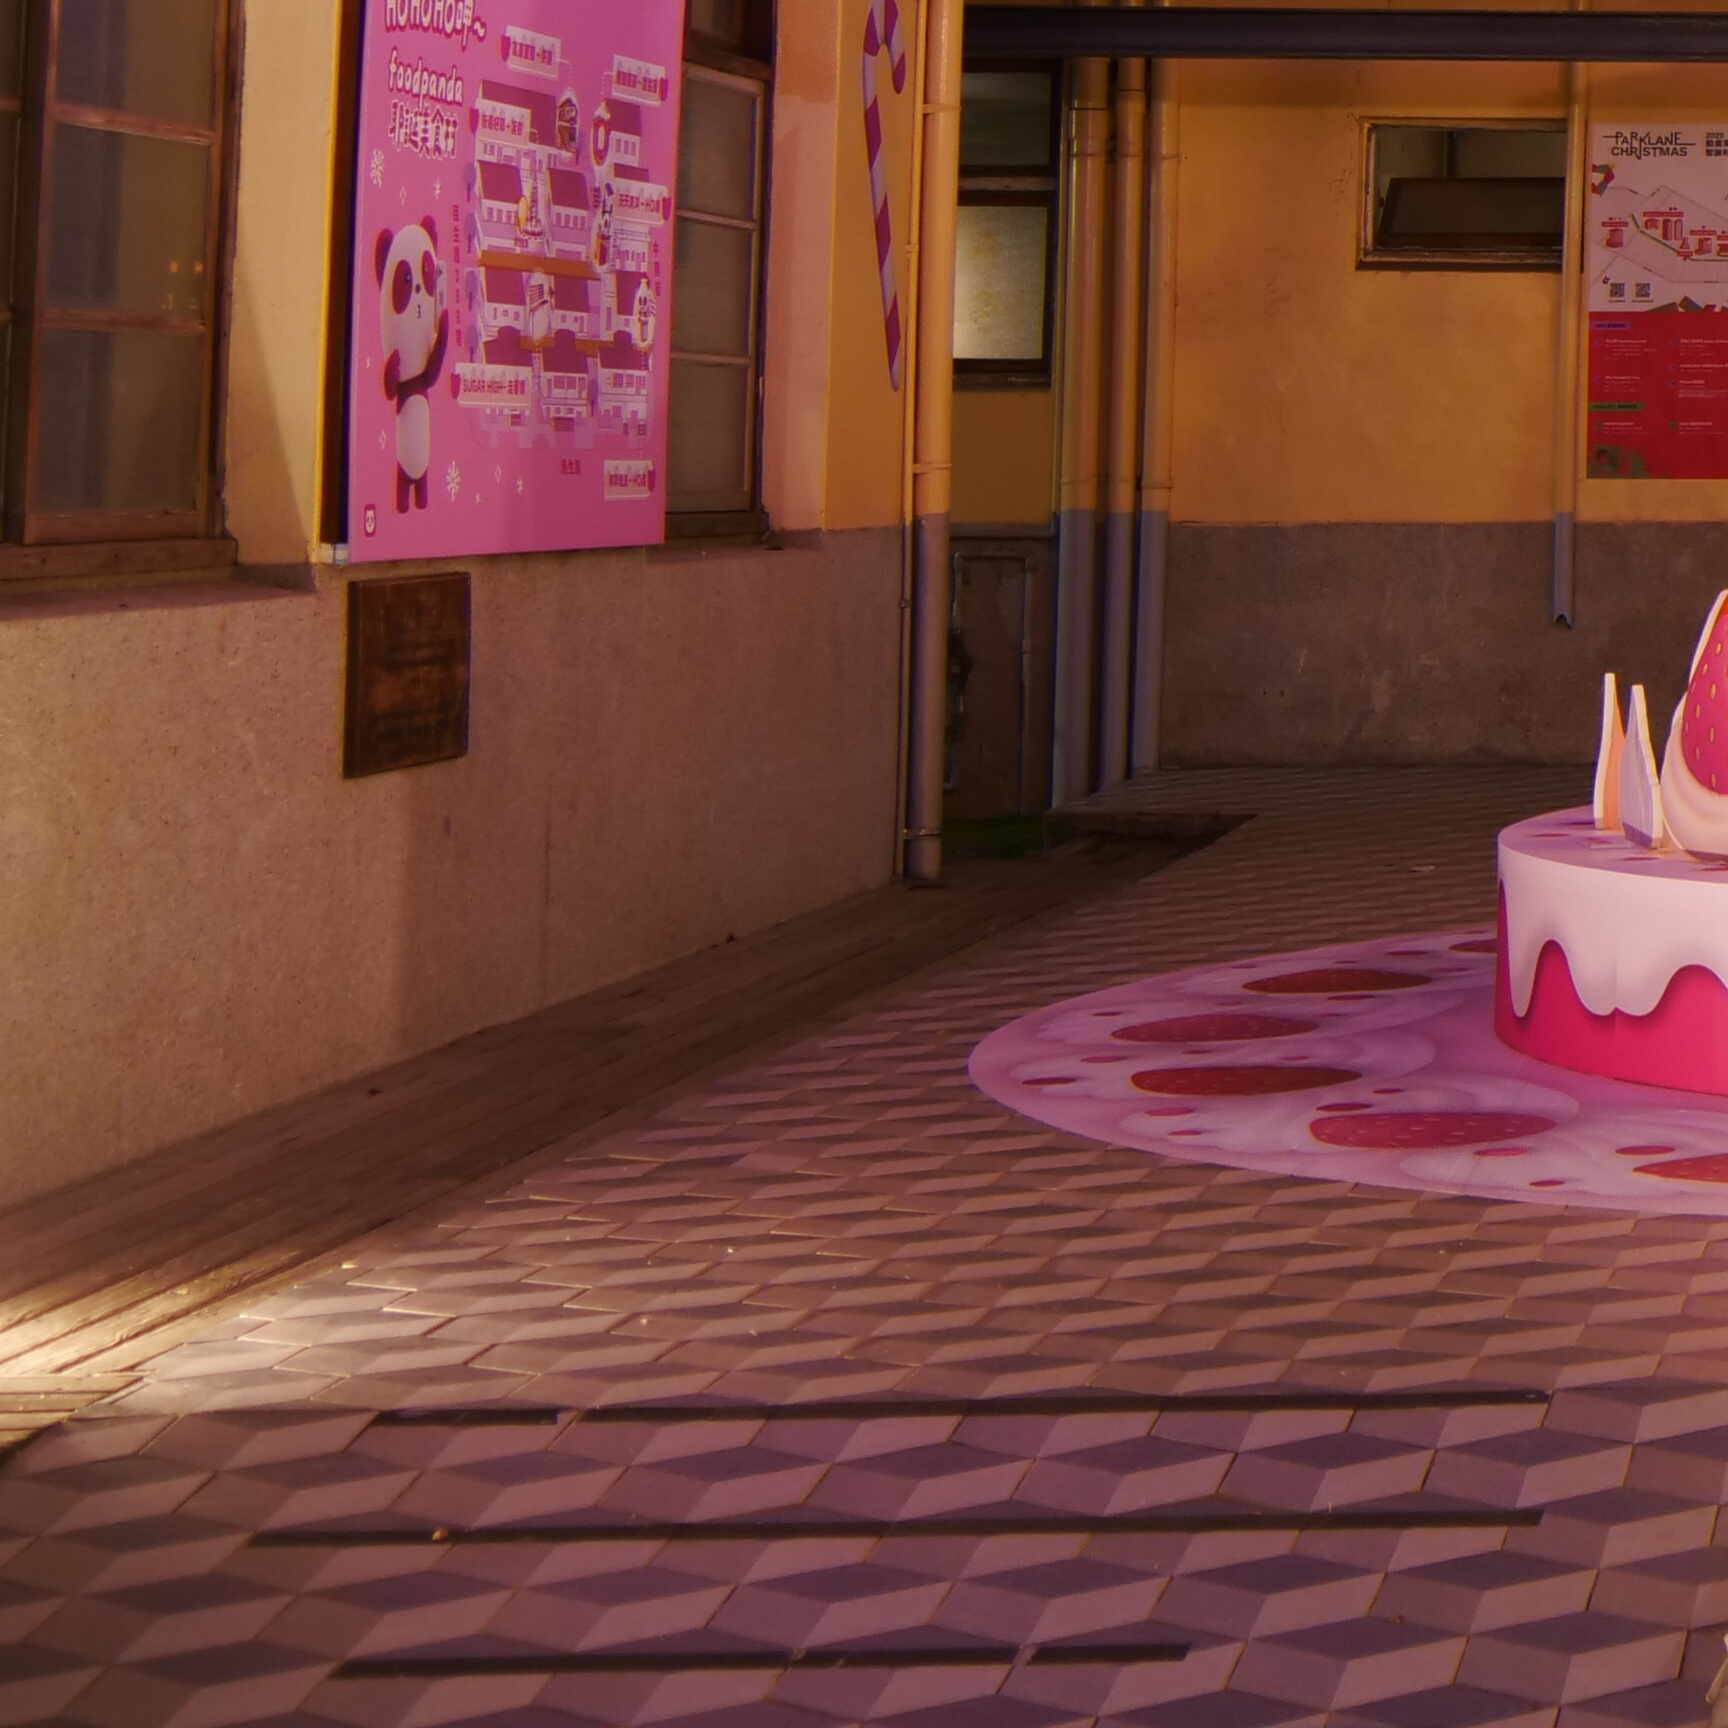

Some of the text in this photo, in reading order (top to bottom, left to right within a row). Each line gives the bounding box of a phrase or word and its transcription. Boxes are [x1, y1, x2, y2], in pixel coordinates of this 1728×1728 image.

[388, 48, 464, 107] foodpanda
[1603, 131, 1696, 148] PARKLANE
[1610, 146, 1688, 160] CHRISTMAS
